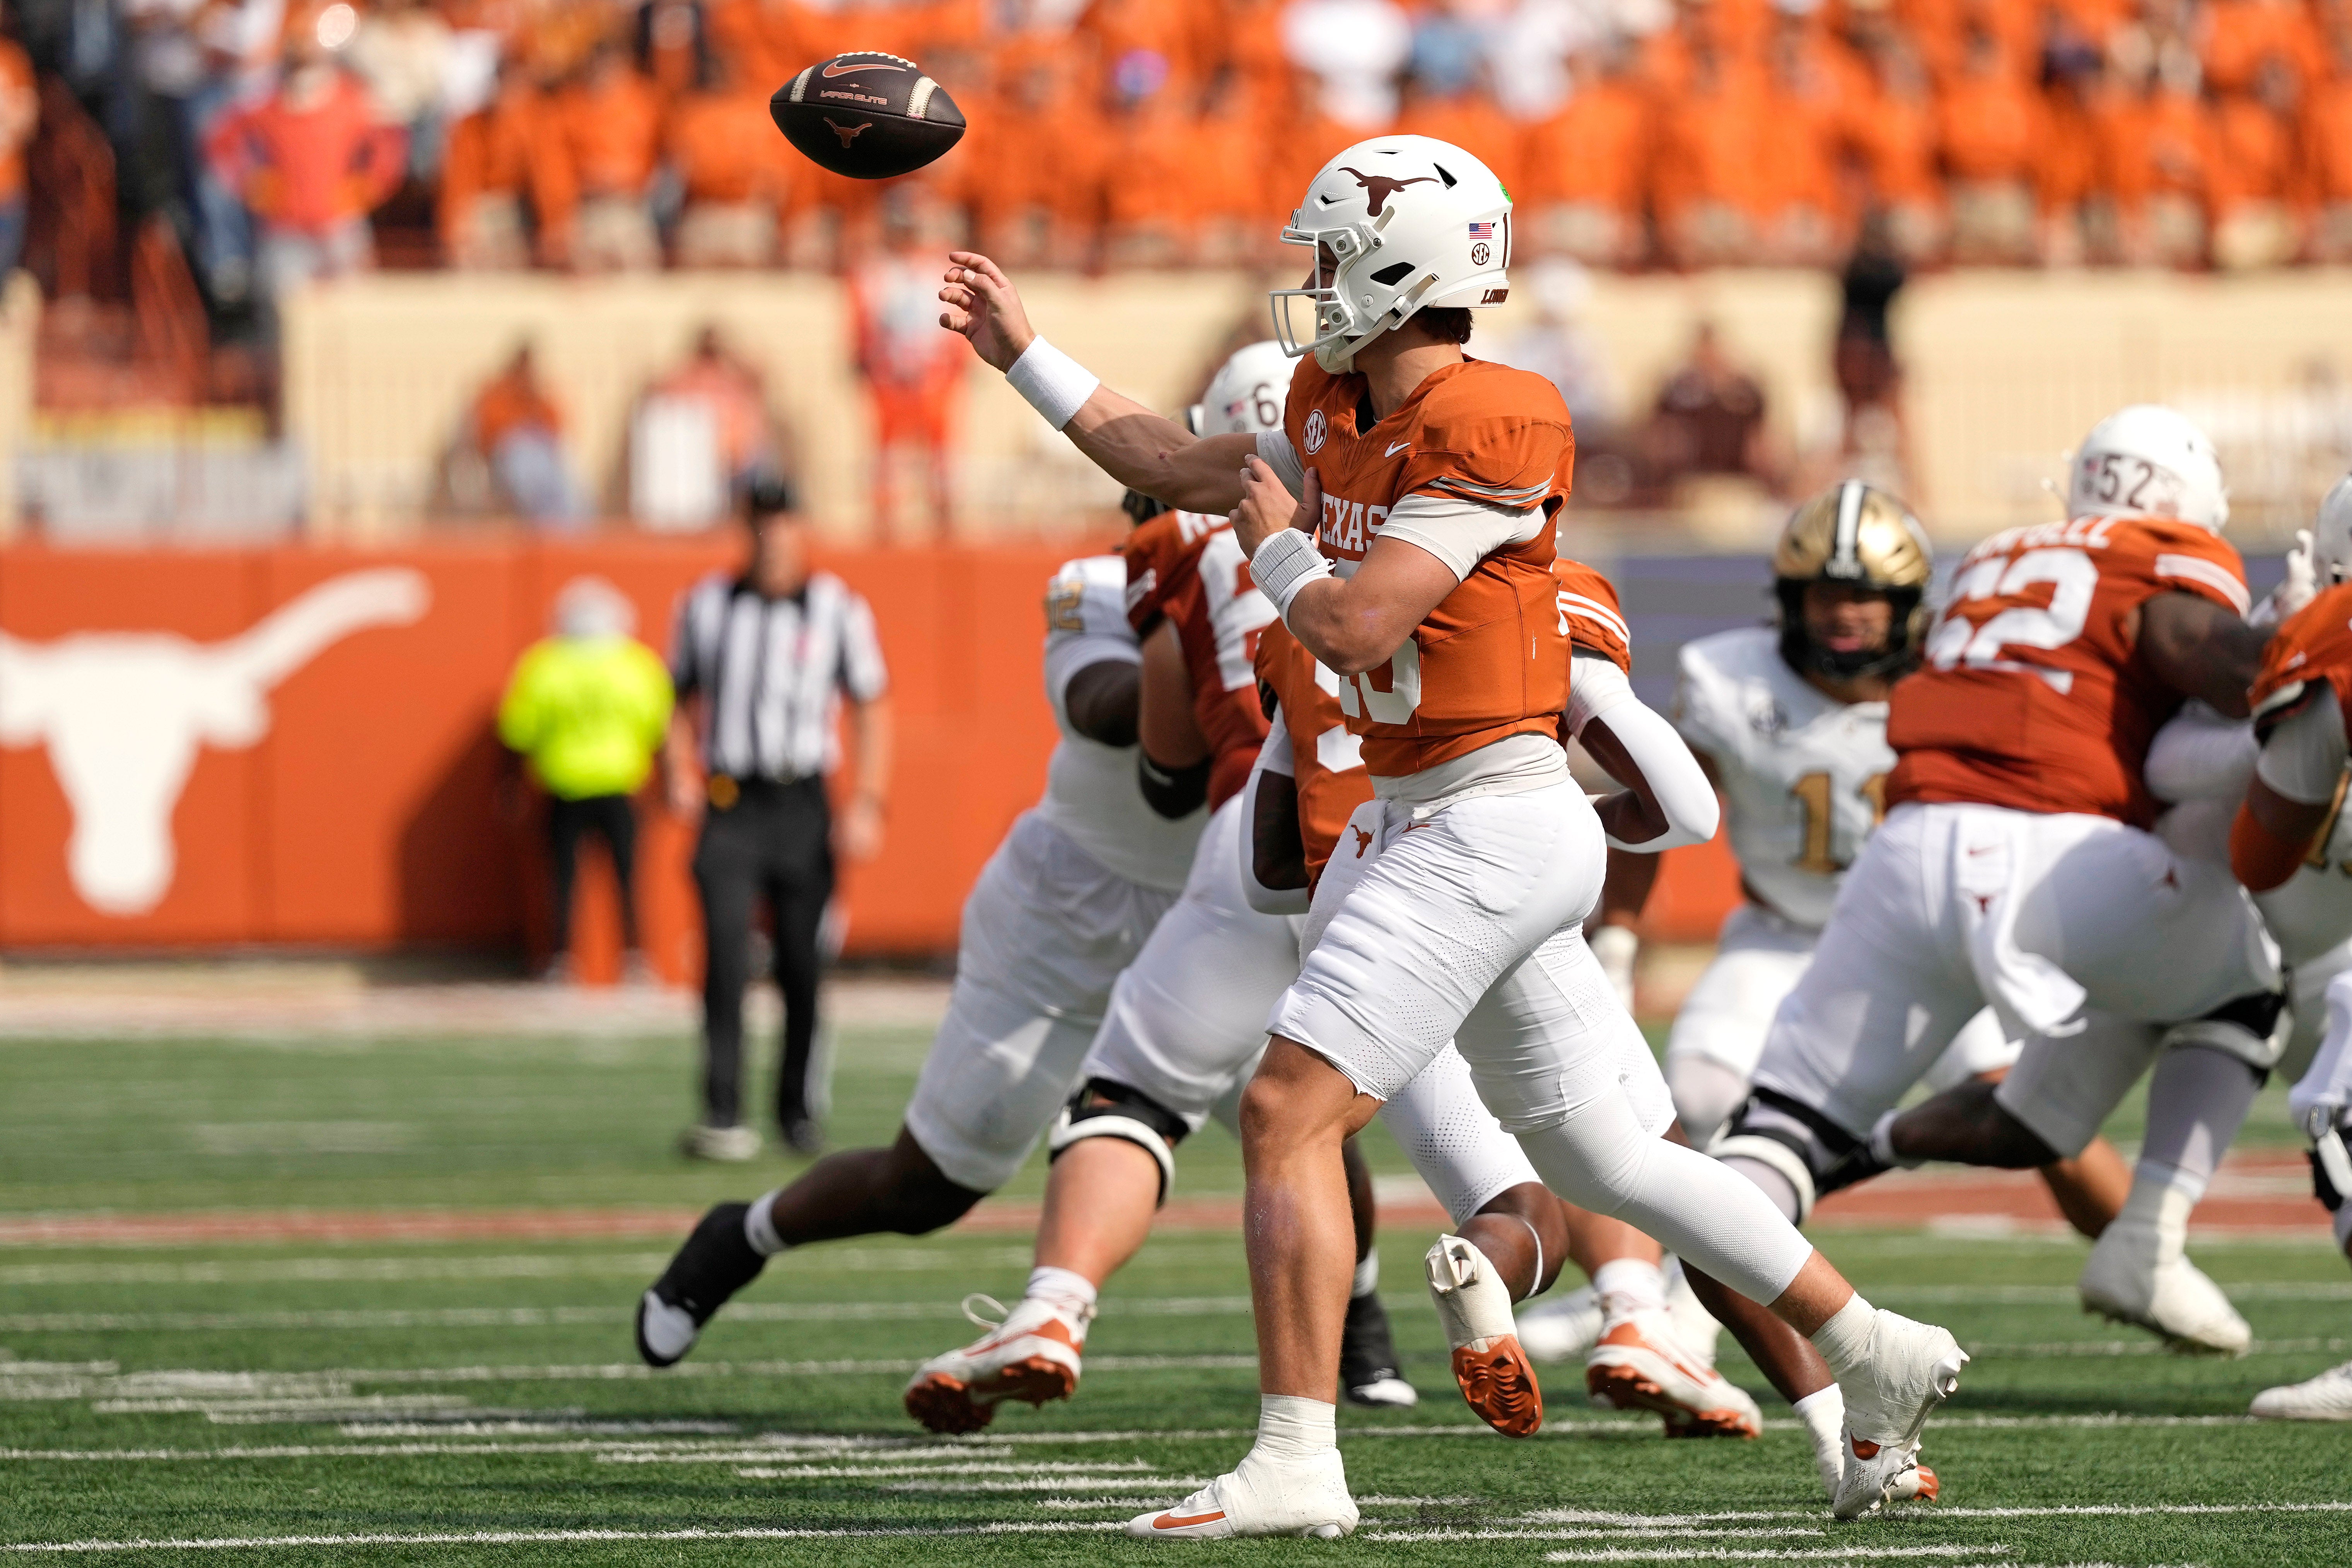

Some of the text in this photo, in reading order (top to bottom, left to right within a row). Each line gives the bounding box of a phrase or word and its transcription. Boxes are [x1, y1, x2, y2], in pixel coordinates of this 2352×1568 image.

[820, 90, 888, 105] VAPOR ELITE
[1472, 243, 1489, 265] SEC
[1305, 411, 1326, 453] SEC
[2099, 453, 2154, 510] 52
[1321, 491, 1388, 552] EXAS
